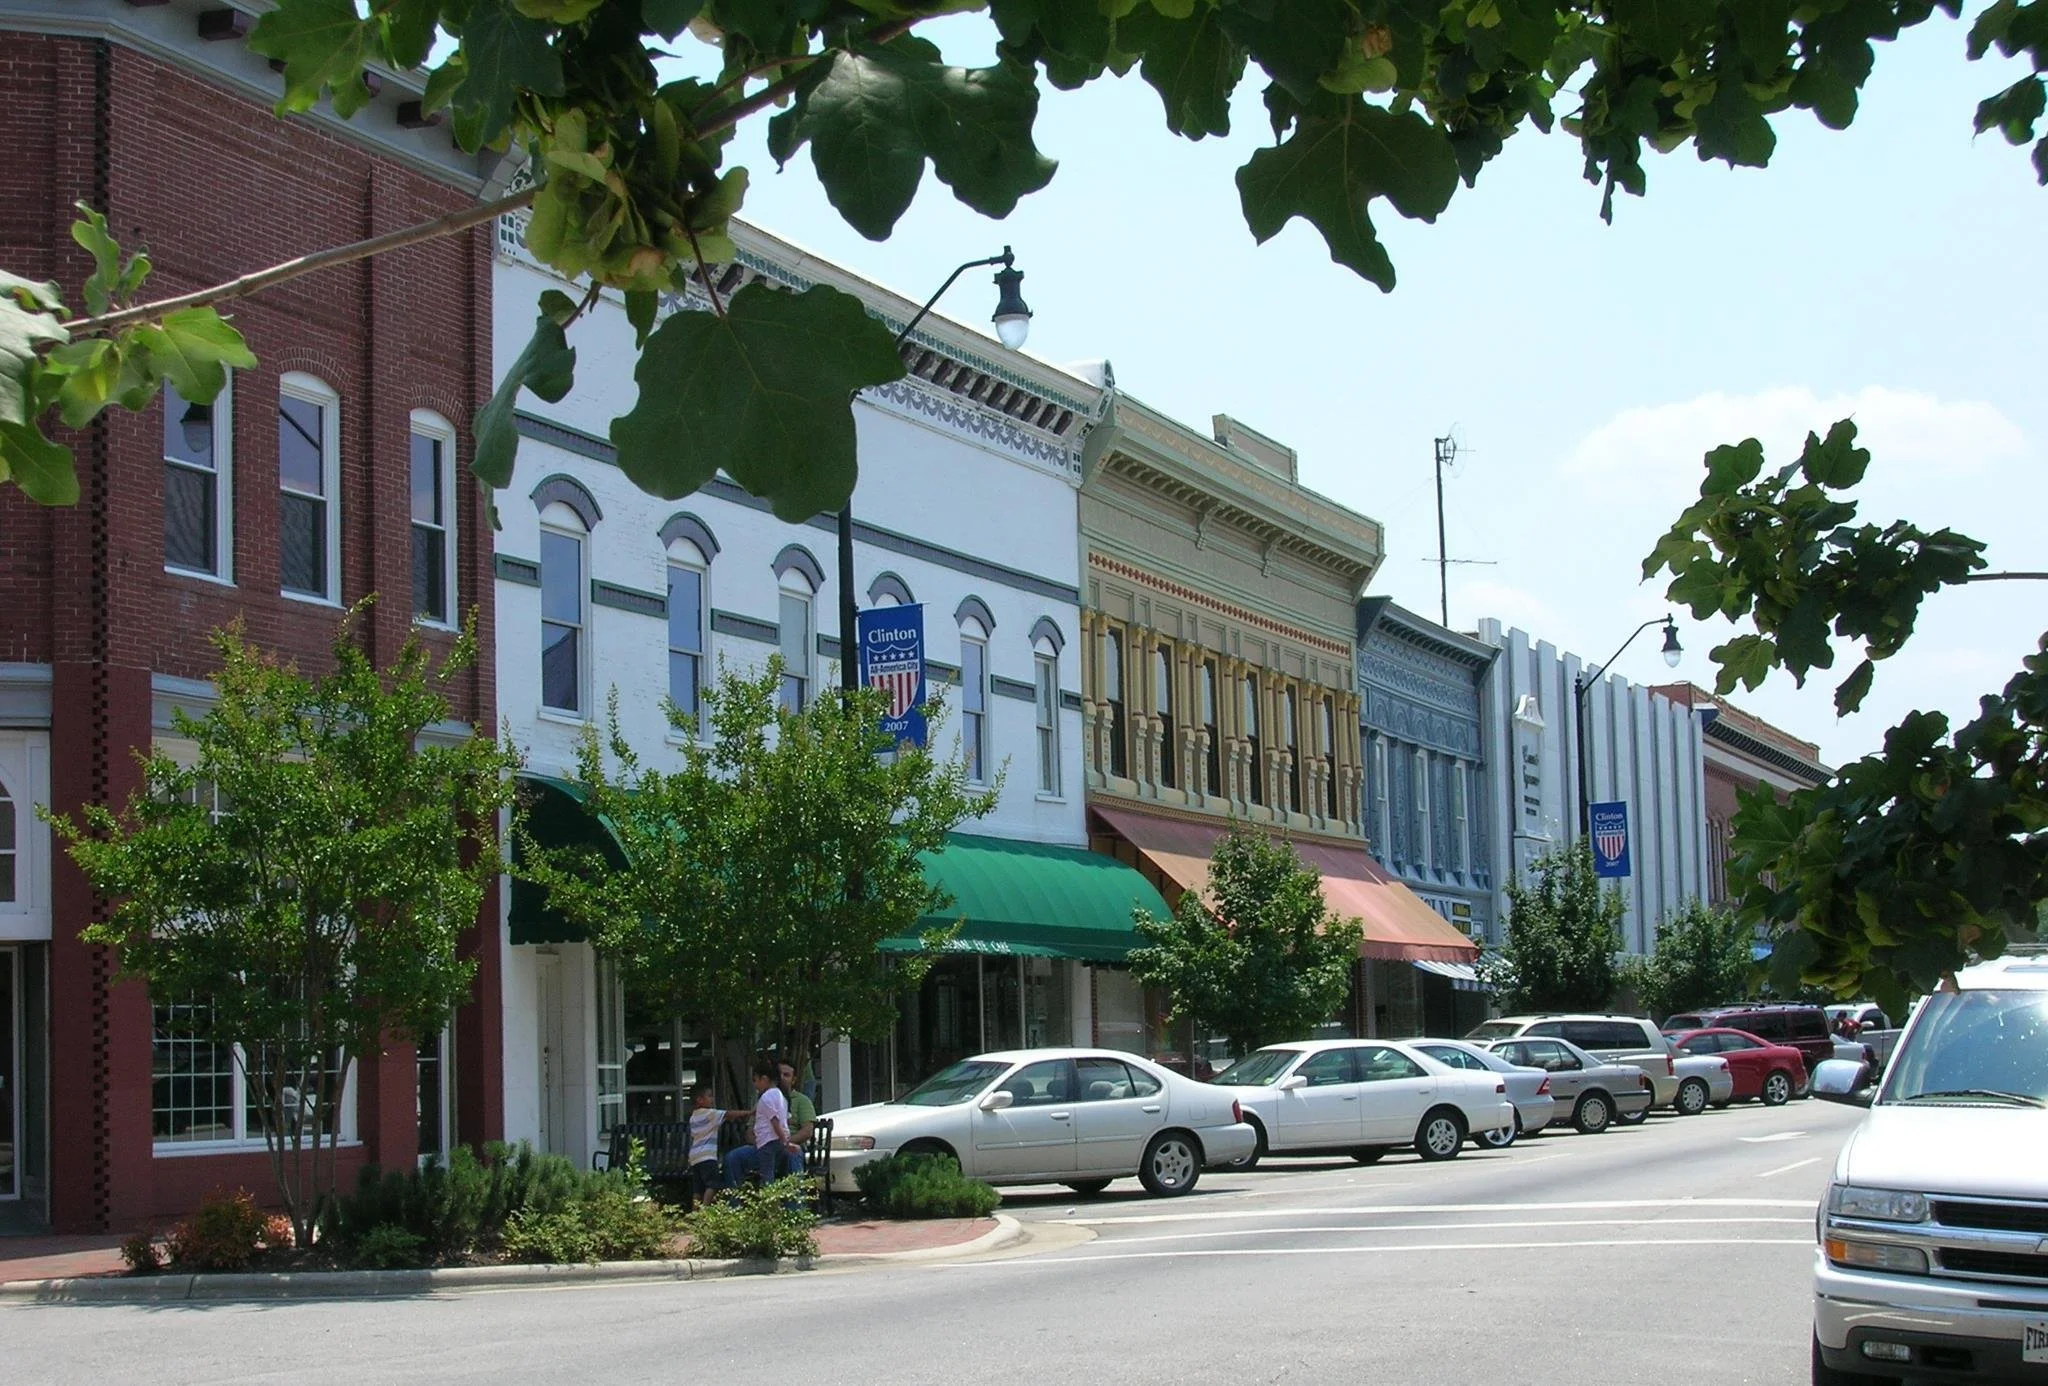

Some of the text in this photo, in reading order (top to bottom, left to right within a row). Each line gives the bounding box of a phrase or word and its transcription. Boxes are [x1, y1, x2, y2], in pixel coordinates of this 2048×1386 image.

[868, 628, 917, 644] Clinton
[884, 721, 909, 732] 2007
[1595, 812, 1624, 821] Clinton
[2026, 1326, 2048, 1351] FIR
